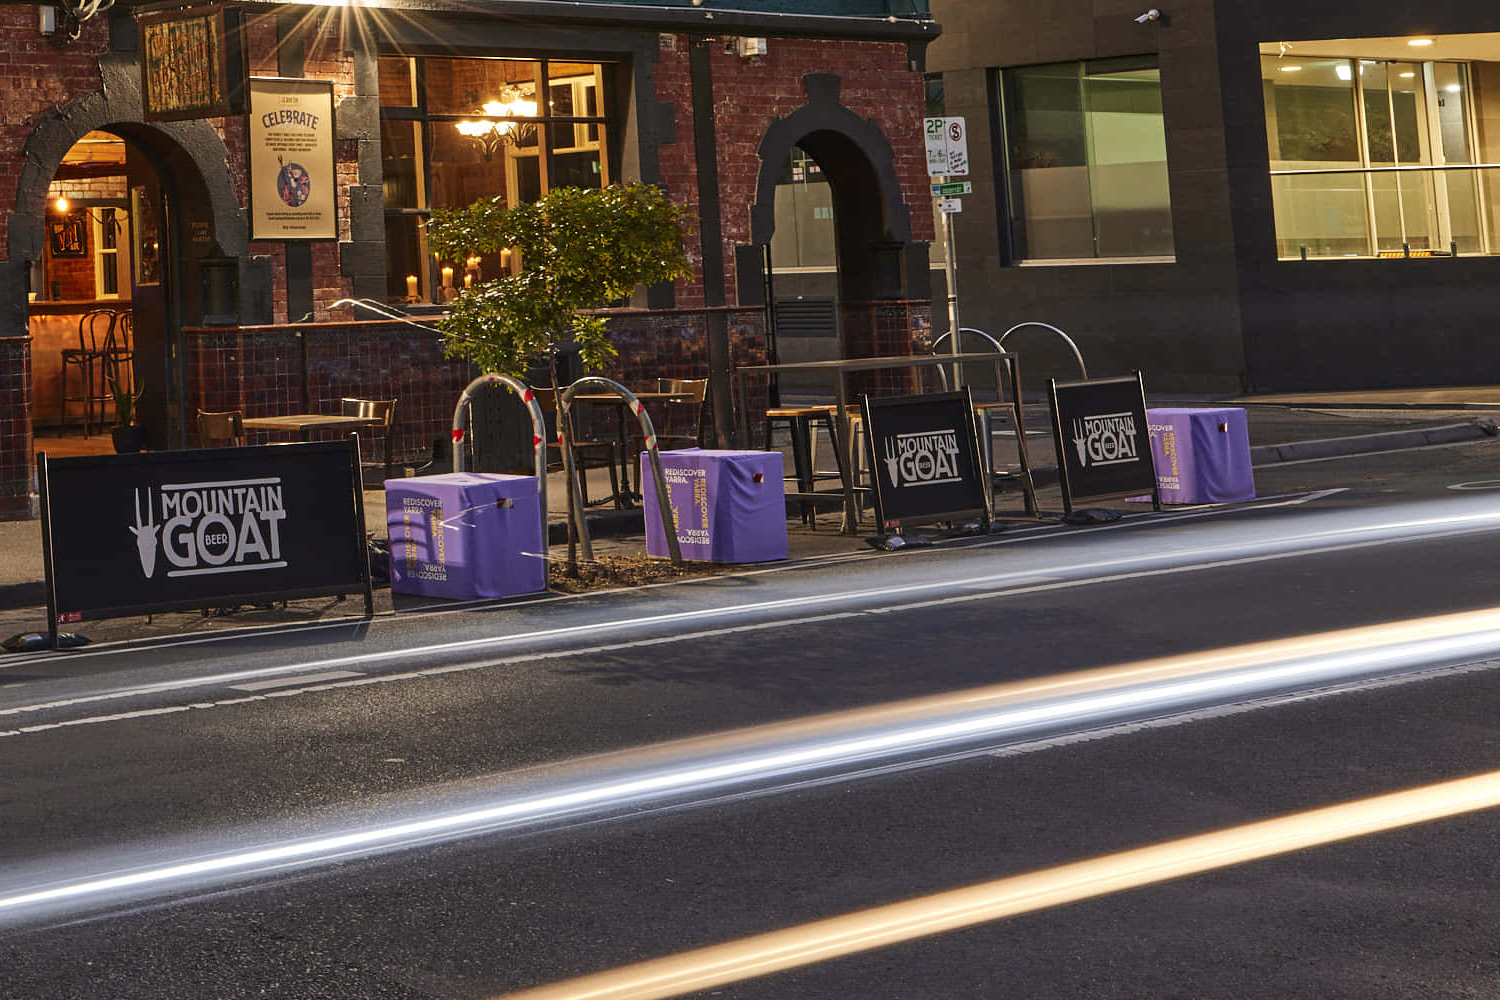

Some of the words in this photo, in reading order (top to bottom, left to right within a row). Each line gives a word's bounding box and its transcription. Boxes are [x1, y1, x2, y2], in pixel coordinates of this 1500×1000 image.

[262, 109, 319, 130] CELEBRATE
[926, 119, 943, 133] 2P
[1085, 416, 1135, 436] MOUNTAIN
[897, 434, 957, 454] MOUNTAIN
[1086, 429, 1137, 461] GOAT
[665, 468, 706, 477] REDISCOVER
[899, 448, 960, 482] GOAT
[161, 485, 283, 519] MOUNTAIN
[162, 509, 287, 568] GOAT
[205, 533, 228, 546] BEER
